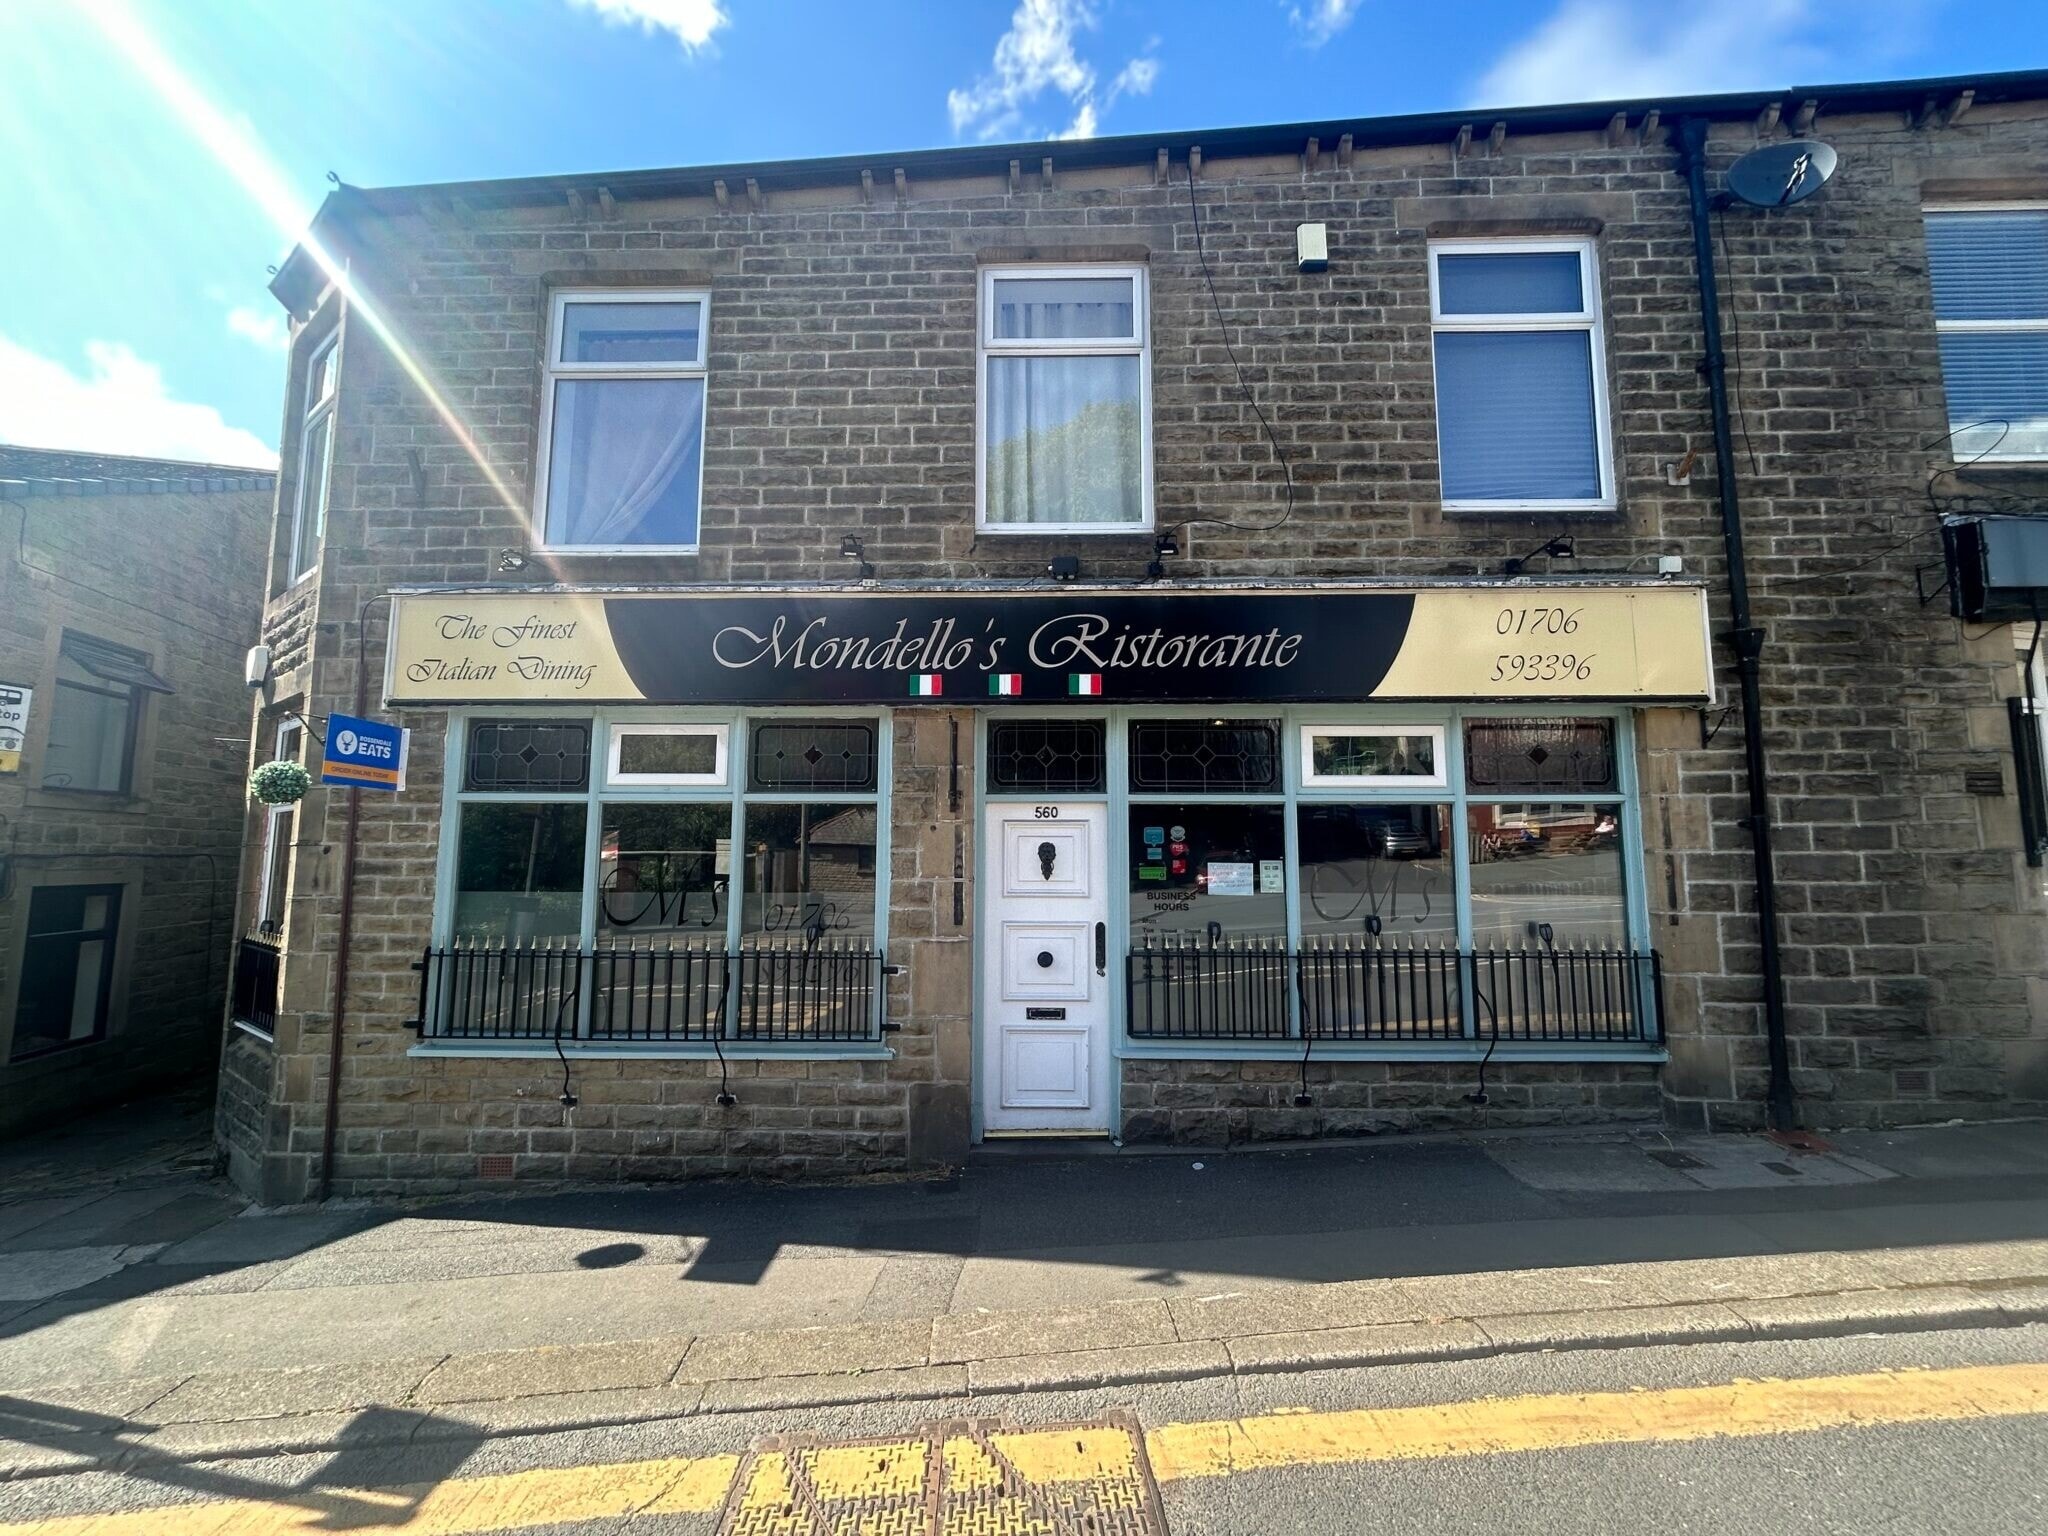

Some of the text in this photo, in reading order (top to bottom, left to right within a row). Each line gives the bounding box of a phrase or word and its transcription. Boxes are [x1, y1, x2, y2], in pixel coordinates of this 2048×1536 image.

[435, 614, 578, 648] The Finest
[1496, 607, 1584, 635] 01706
[712, 613, 1303, 671] Mondello's Ristorante
[406, 656, 597, 690] Italian Dining
[1490, 653, 1597, 682] 593396
[358, 743, 391, 759] EATS
[1034, 806, 1059, 819] 560
[1146, 891, 1197, 901] BUSINESS
[1154, 902, 1190, 911] HOURS
[764, 902, 860, 932] 01706
